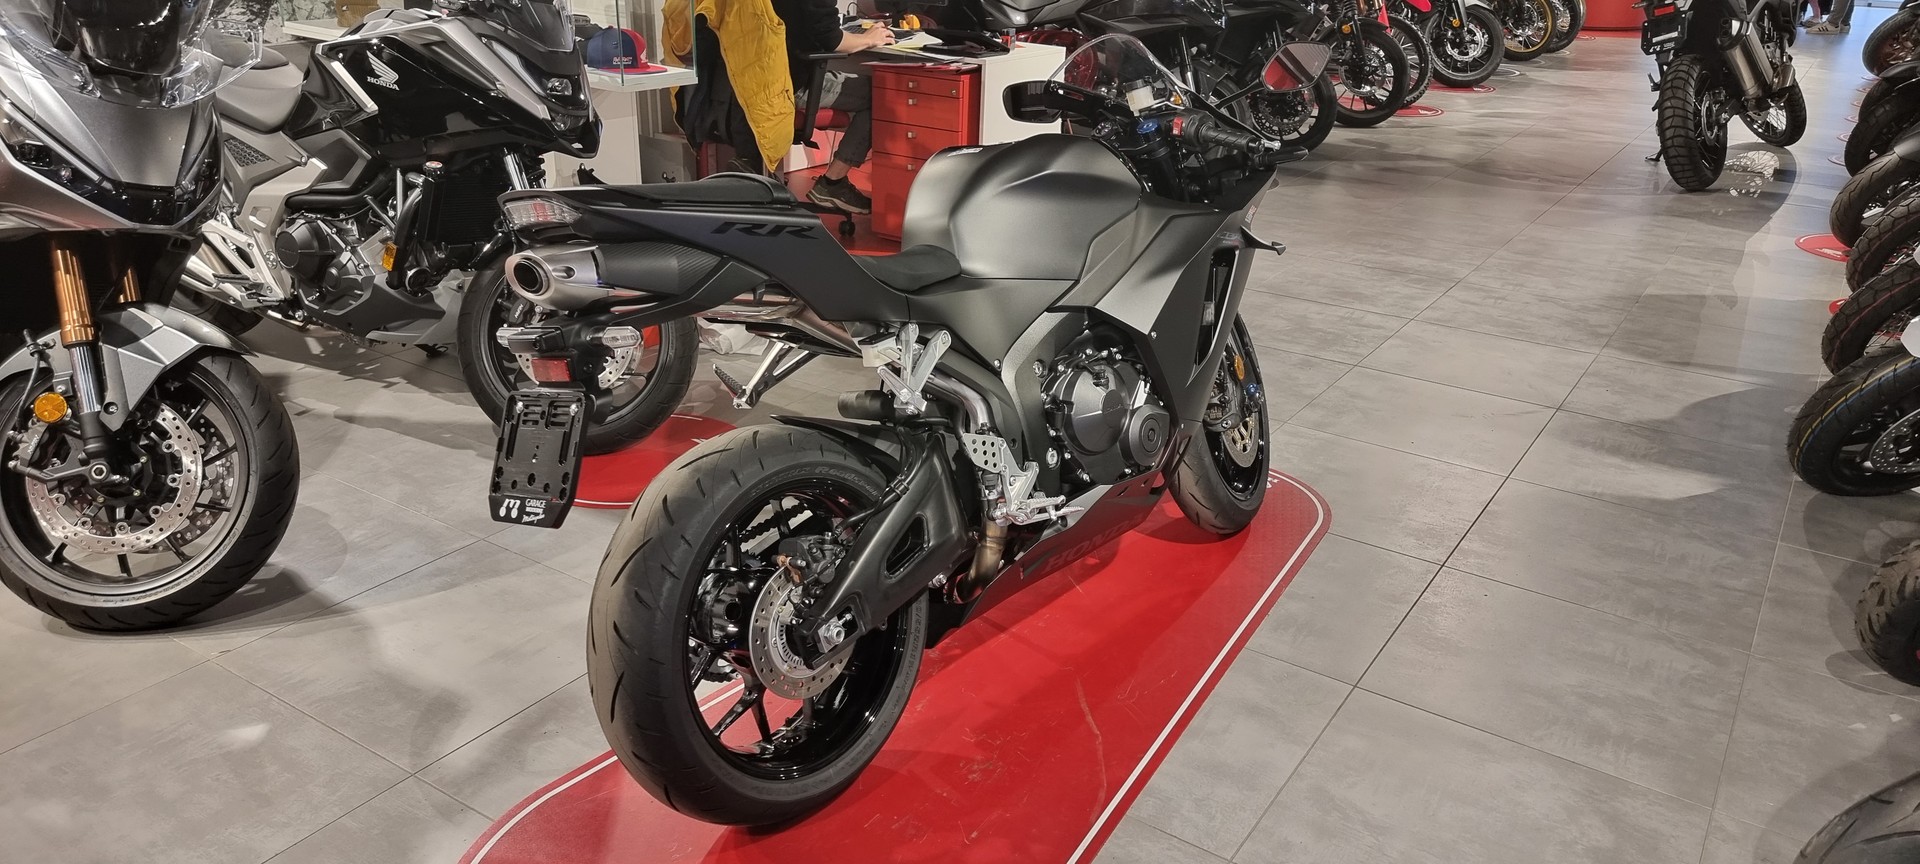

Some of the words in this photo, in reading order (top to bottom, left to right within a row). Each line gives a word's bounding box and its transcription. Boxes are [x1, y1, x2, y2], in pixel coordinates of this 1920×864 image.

[367, 76, 400, 90] HONDA
[710, 221, 819, 239] RR
[525, 499, 546, 508] GARAGE
